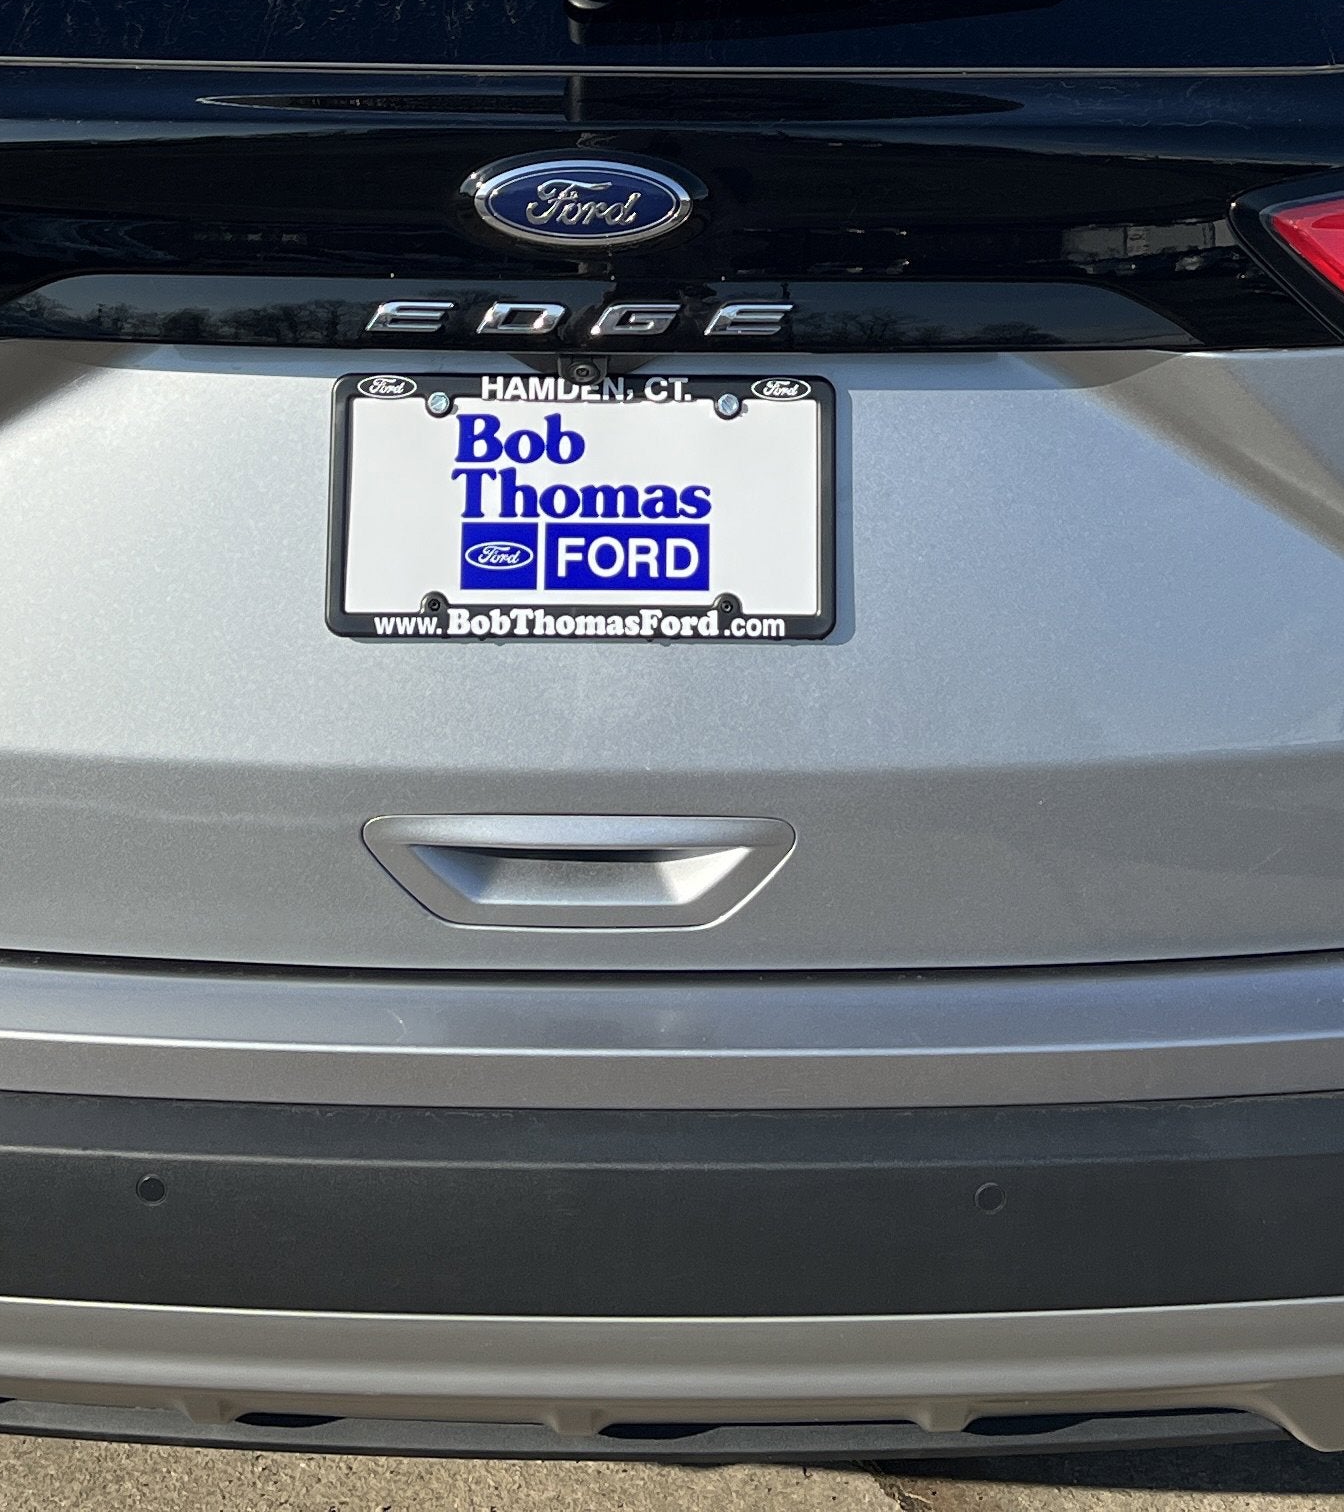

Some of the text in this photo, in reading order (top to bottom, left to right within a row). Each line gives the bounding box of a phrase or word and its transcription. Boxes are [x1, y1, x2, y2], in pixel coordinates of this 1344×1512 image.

[525, 179, 642, 226] Ford
[364, 301, 795, 336] EDGE
[644, 376, 692, 402] CT.
[454, 413, 586, 465] Bob
[451, 466, 712, 520] Thomas
[477, 543, 521, 566] Ford
[556, 536, 699, 579] FORD
[373, 608, 786, 638] www.BobThomasFord.com
